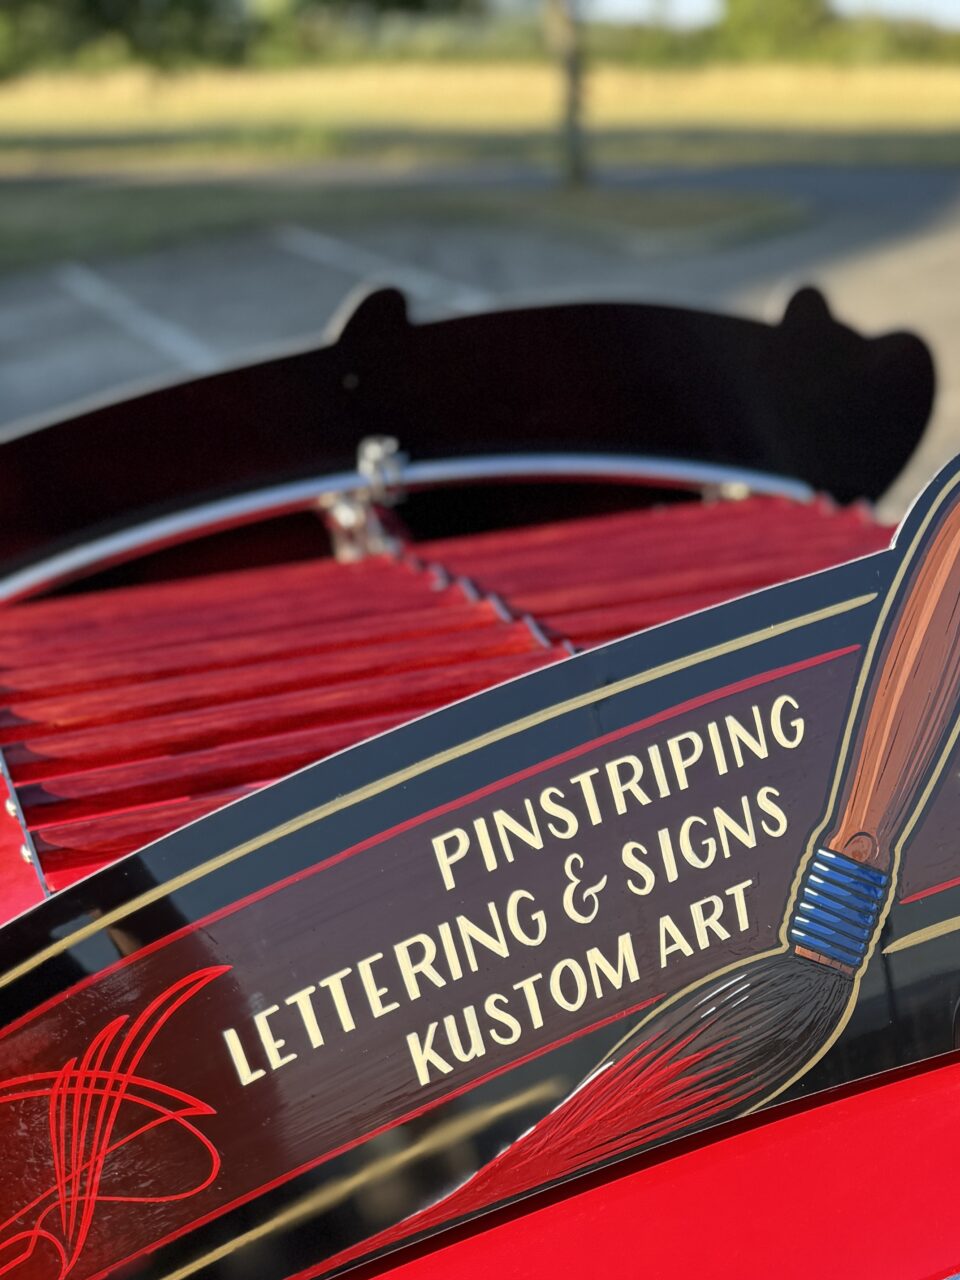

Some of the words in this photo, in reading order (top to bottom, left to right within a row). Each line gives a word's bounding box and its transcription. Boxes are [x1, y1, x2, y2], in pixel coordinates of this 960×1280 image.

[431, 694, 806, 891] PINSTRIPING
[222, 889, 547, 1087] LETTERING
[562, 853, 608, 925] &
[621, 786, 790, 897] SIGNS
[406, 932, 641, 1086] KUSTOM
[659, 879, 753, 970] ART
